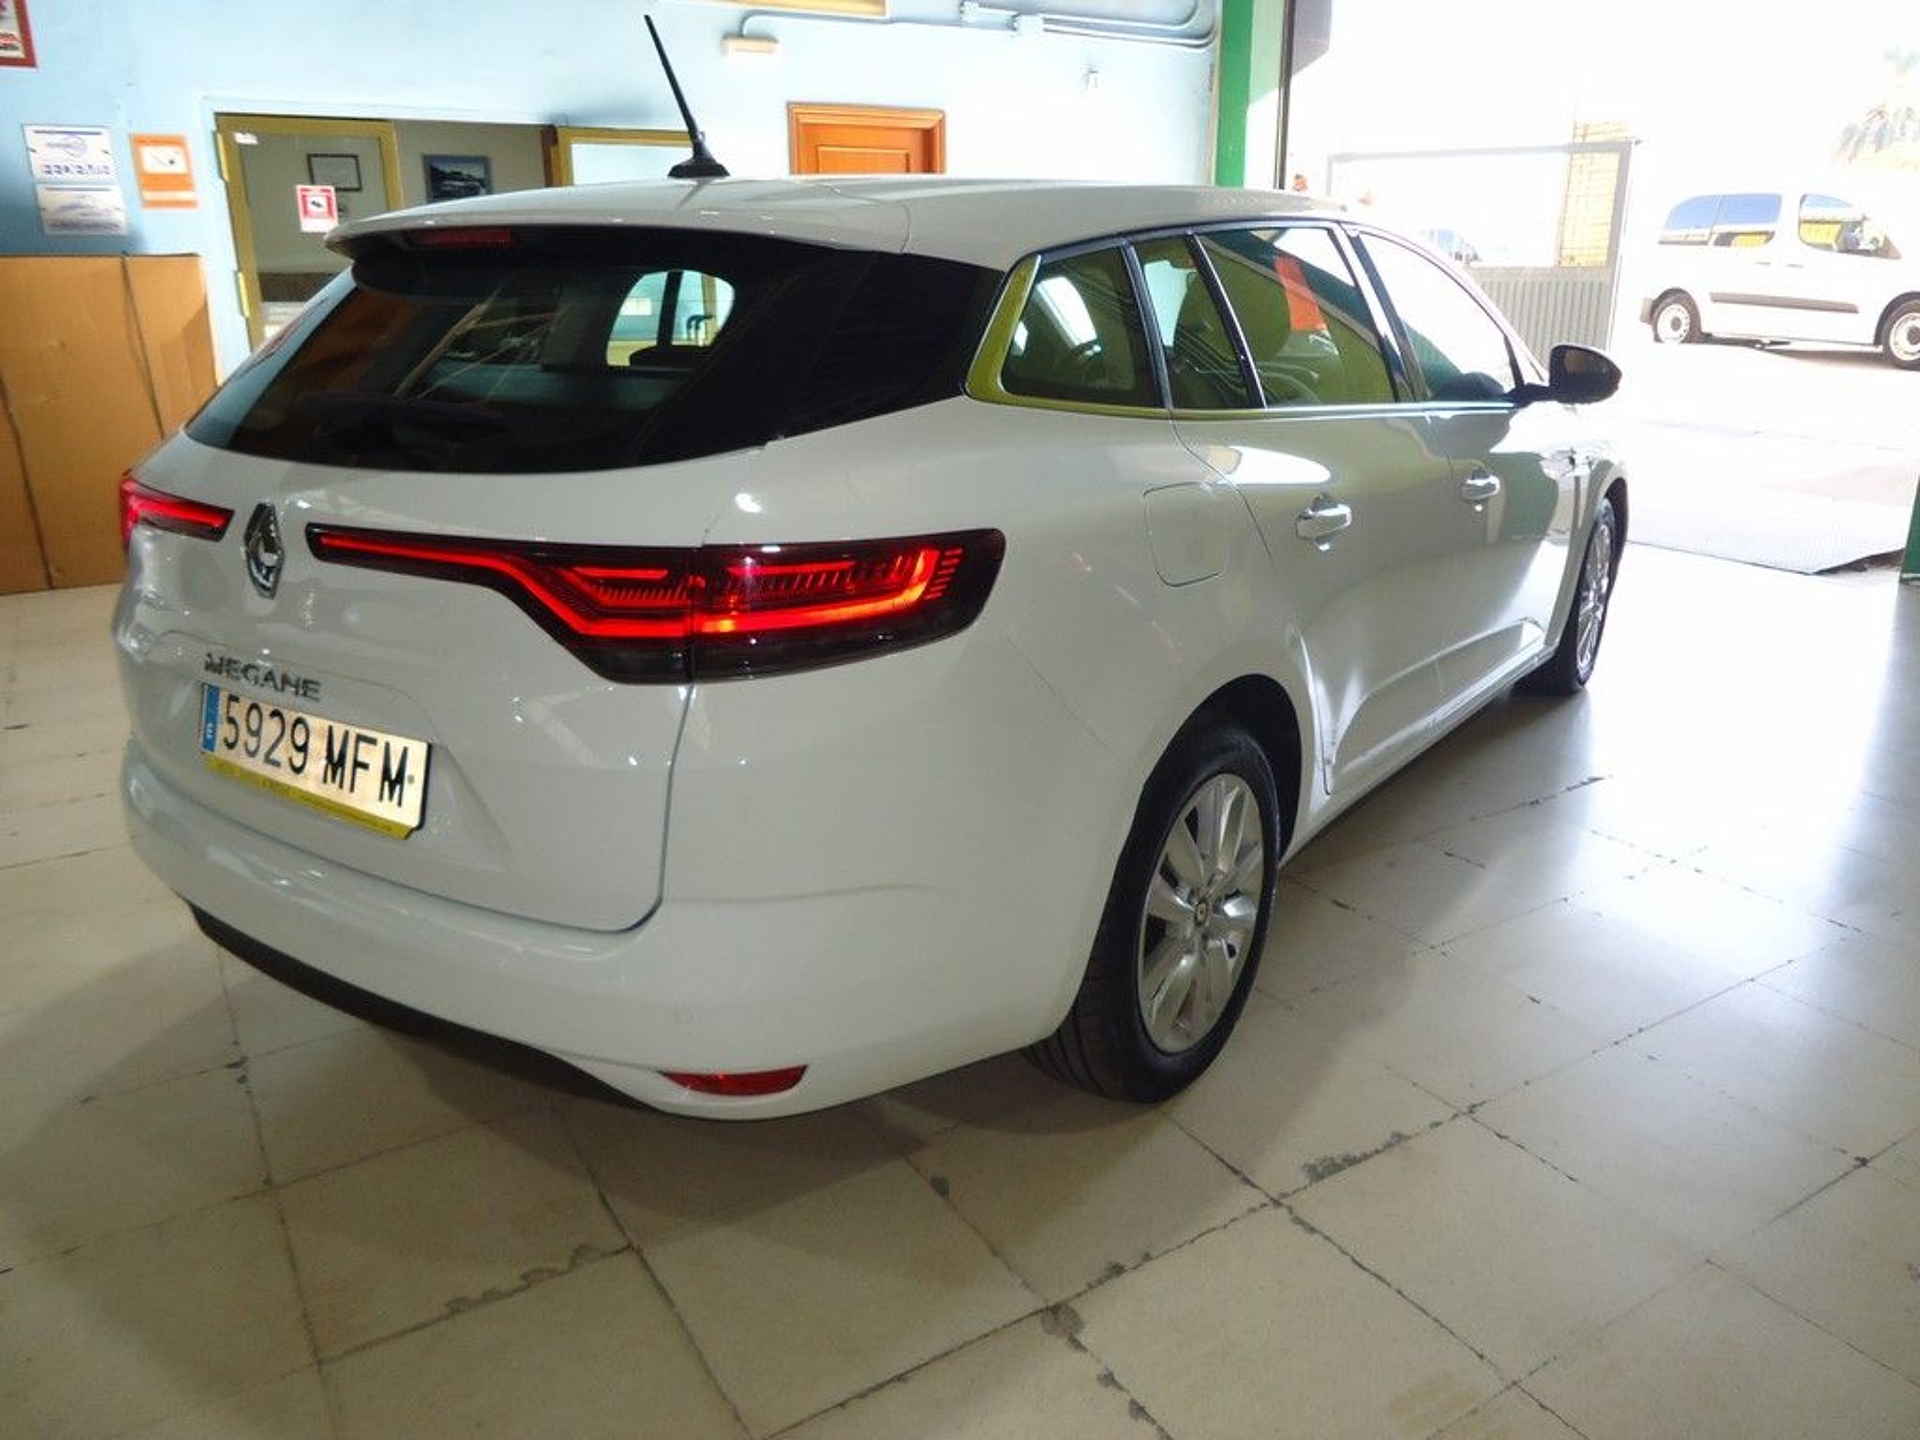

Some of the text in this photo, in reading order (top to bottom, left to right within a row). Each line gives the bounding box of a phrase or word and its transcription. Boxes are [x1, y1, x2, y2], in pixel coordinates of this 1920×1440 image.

[204, 653, 321, 702] MEGANE
[223, 693, 408, 808] 5929 MFM
